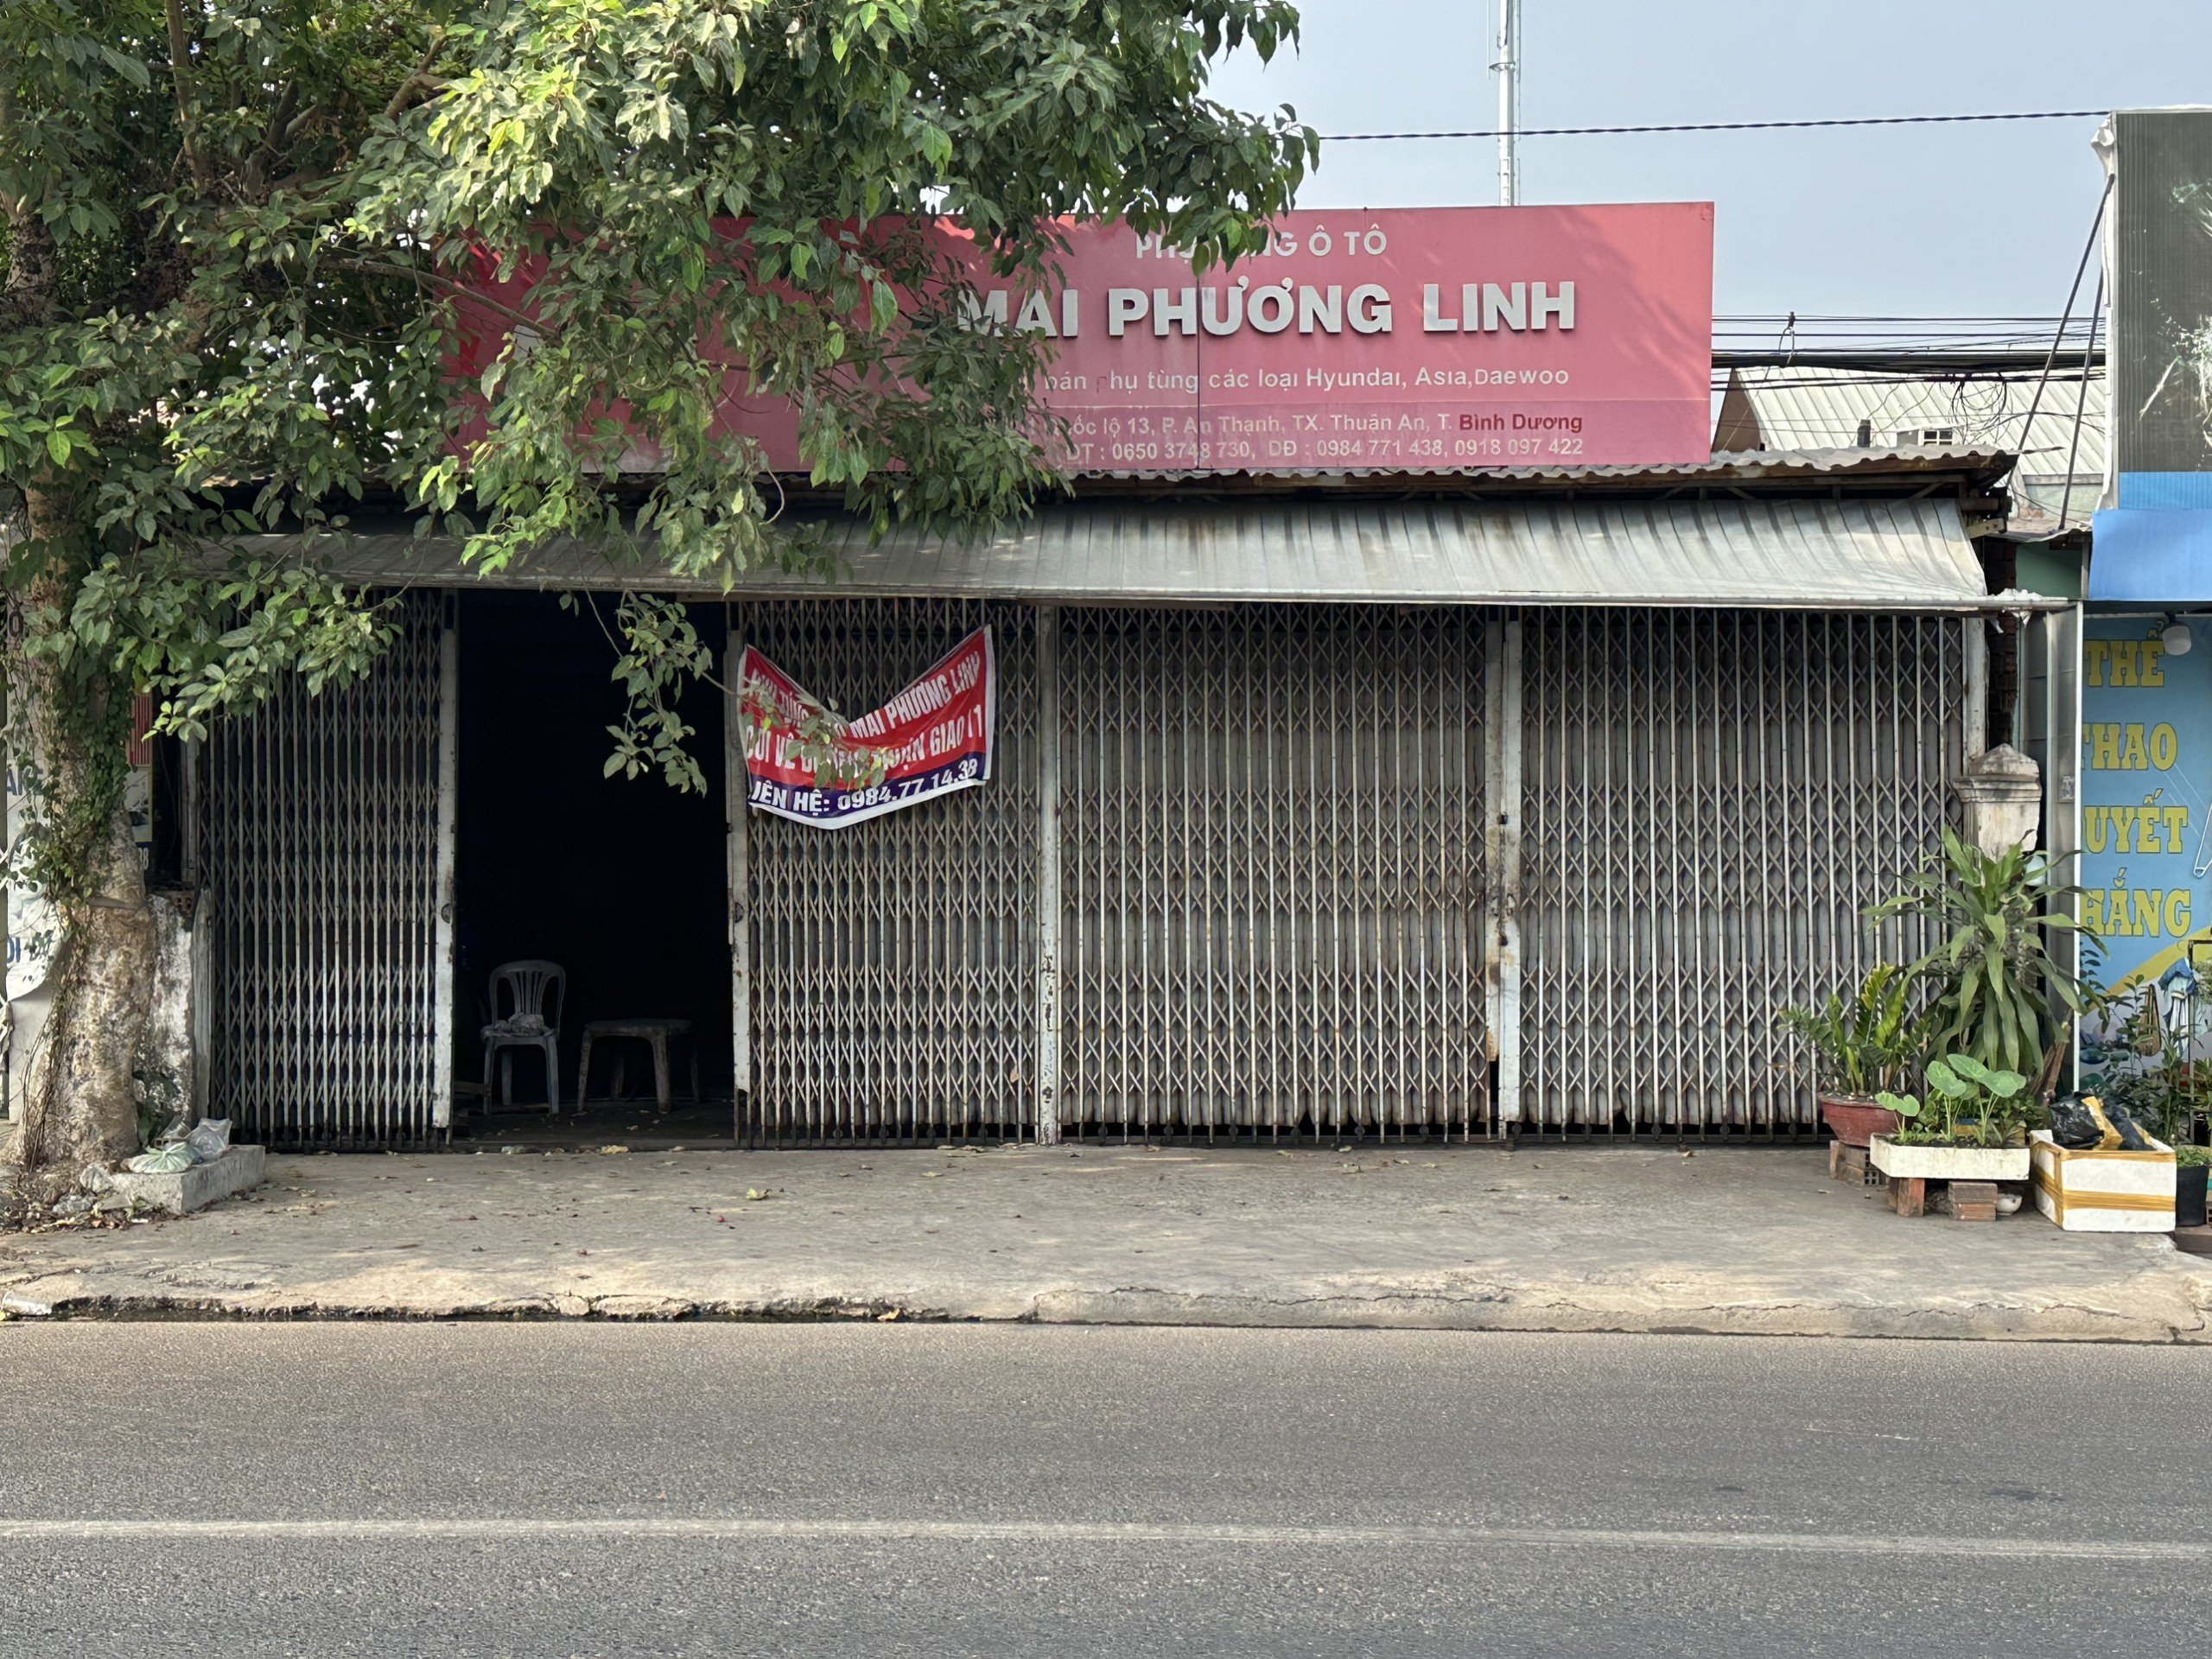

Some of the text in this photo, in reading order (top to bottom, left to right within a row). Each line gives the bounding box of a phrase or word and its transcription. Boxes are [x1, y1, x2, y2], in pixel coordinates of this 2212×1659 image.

[1308, 225, 1332, 257] Ô
[1344, 223, 1387, 256] TÔ
[957, 275, 1575, 337] MAI PHƯƠNG LINH
[1147, 369, 1199, 394] tùng
[1209, 368, 1249, 388] các
[1258, 368, 1298, 391] loại
[1306, 367, 1408, 391] Hyundai,
[1103, 416, 1121, 437] lộ
[1128, 416, 1155, 435] 13,
[1162, 416, 1178, 433] P.
[1185, 416, 1211, 434] An
[1217, 415, 1286, 436] Thạnh,
[1292, 413, 1325, 432] TX.
[1330, 413, 1392, 435] Thuận
[1397, 413, 1430, 433] An,
[1437, 412, 1452, 430] T.
[1459, 413, 1505, 431] Bình
[1512, 413, 1583, 433] Dương
[1111, 442, 1158, 461] 0650
[1164, 442, 1211, 460] 3748
[1217, 441, 1256, 461] 730,
[1268, 439, 1297, 456] DĐ
[1317, 439, 1363, 457] 0984
[1369, 438, 1402, 456] 771
[1408, 438, 1448, 458] 438,
[1454, 438, 1501, 456] 0918
[1508, 438, 1542, 455] 097
[1548, 437, 1584, 455] 422
[849, 709, 887, 740] MAI
[883, 673, 953, 730] PHƯƠNG
[930, 715, 965, 757] GIAO
[792, 788, 830, 817] HỆ:
